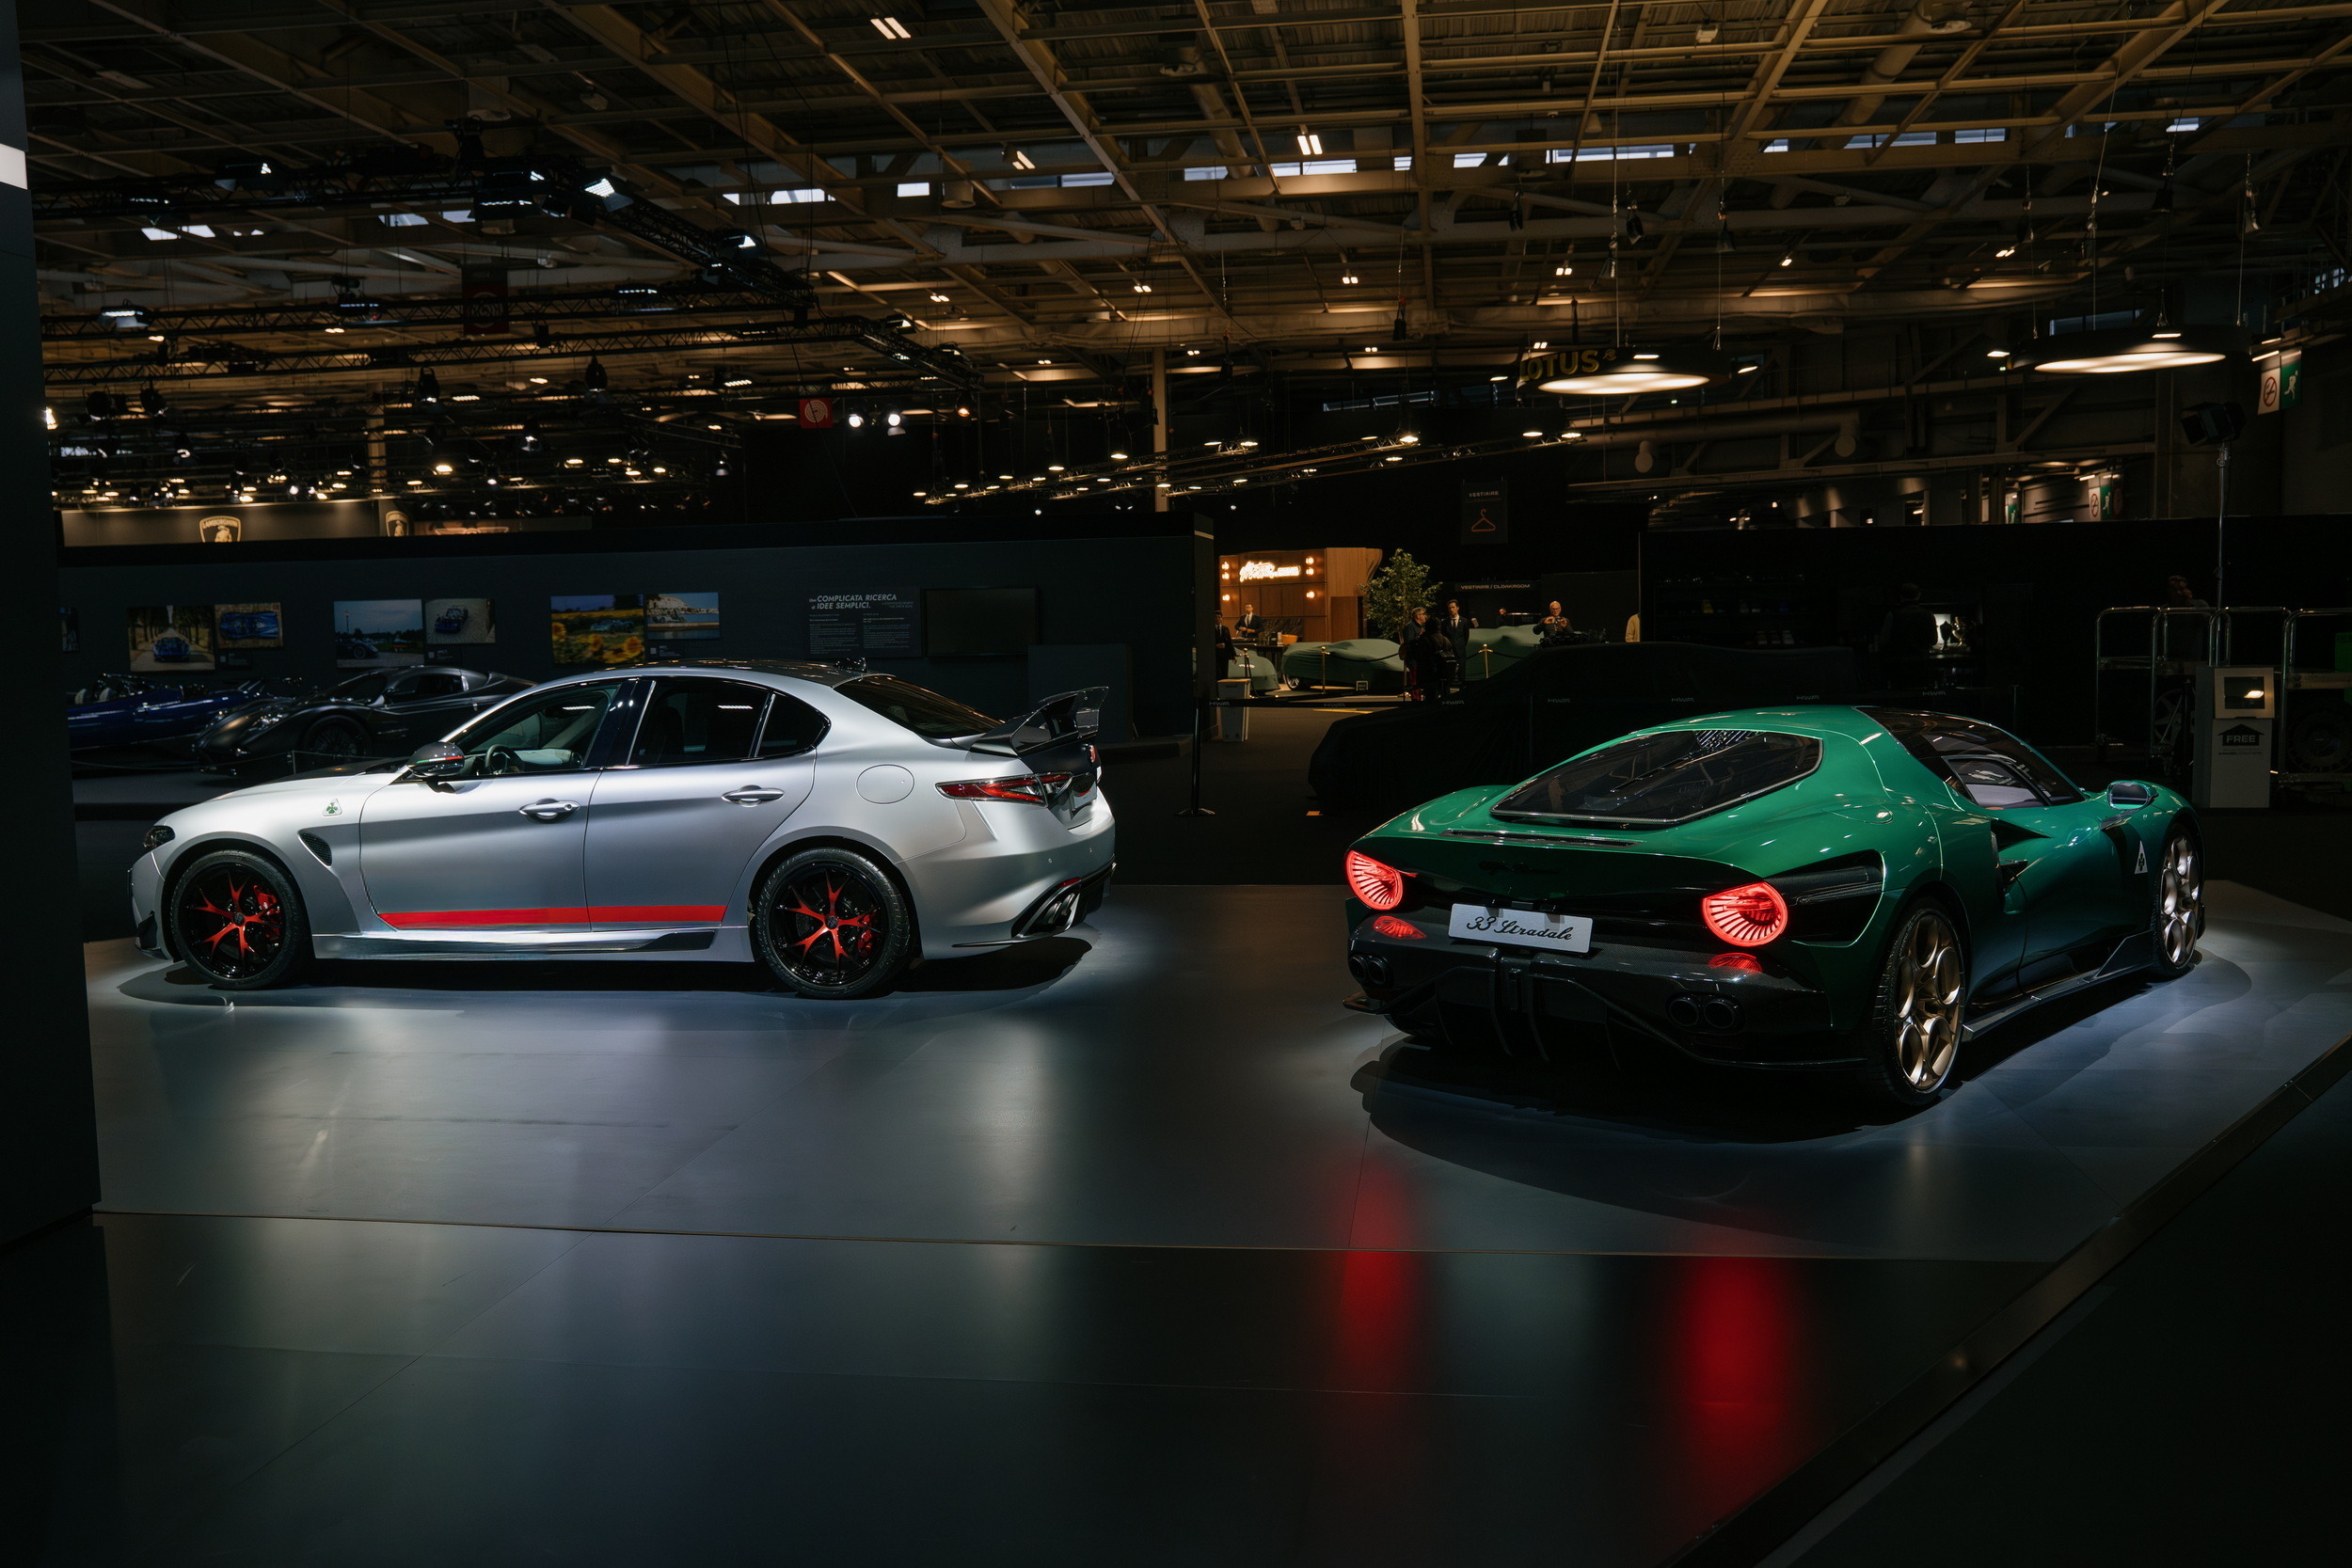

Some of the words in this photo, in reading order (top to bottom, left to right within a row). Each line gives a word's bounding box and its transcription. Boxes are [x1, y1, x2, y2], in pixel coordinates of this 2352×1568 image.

[1519, 349, 1599, 382] LOTUS
[866, 594, 897, 602] RICERCA
[2226, 735, 2256, 743] FREE
[1466, 915, 1497, 931] 33
[1494, 920, 1574, 941] Stradale
